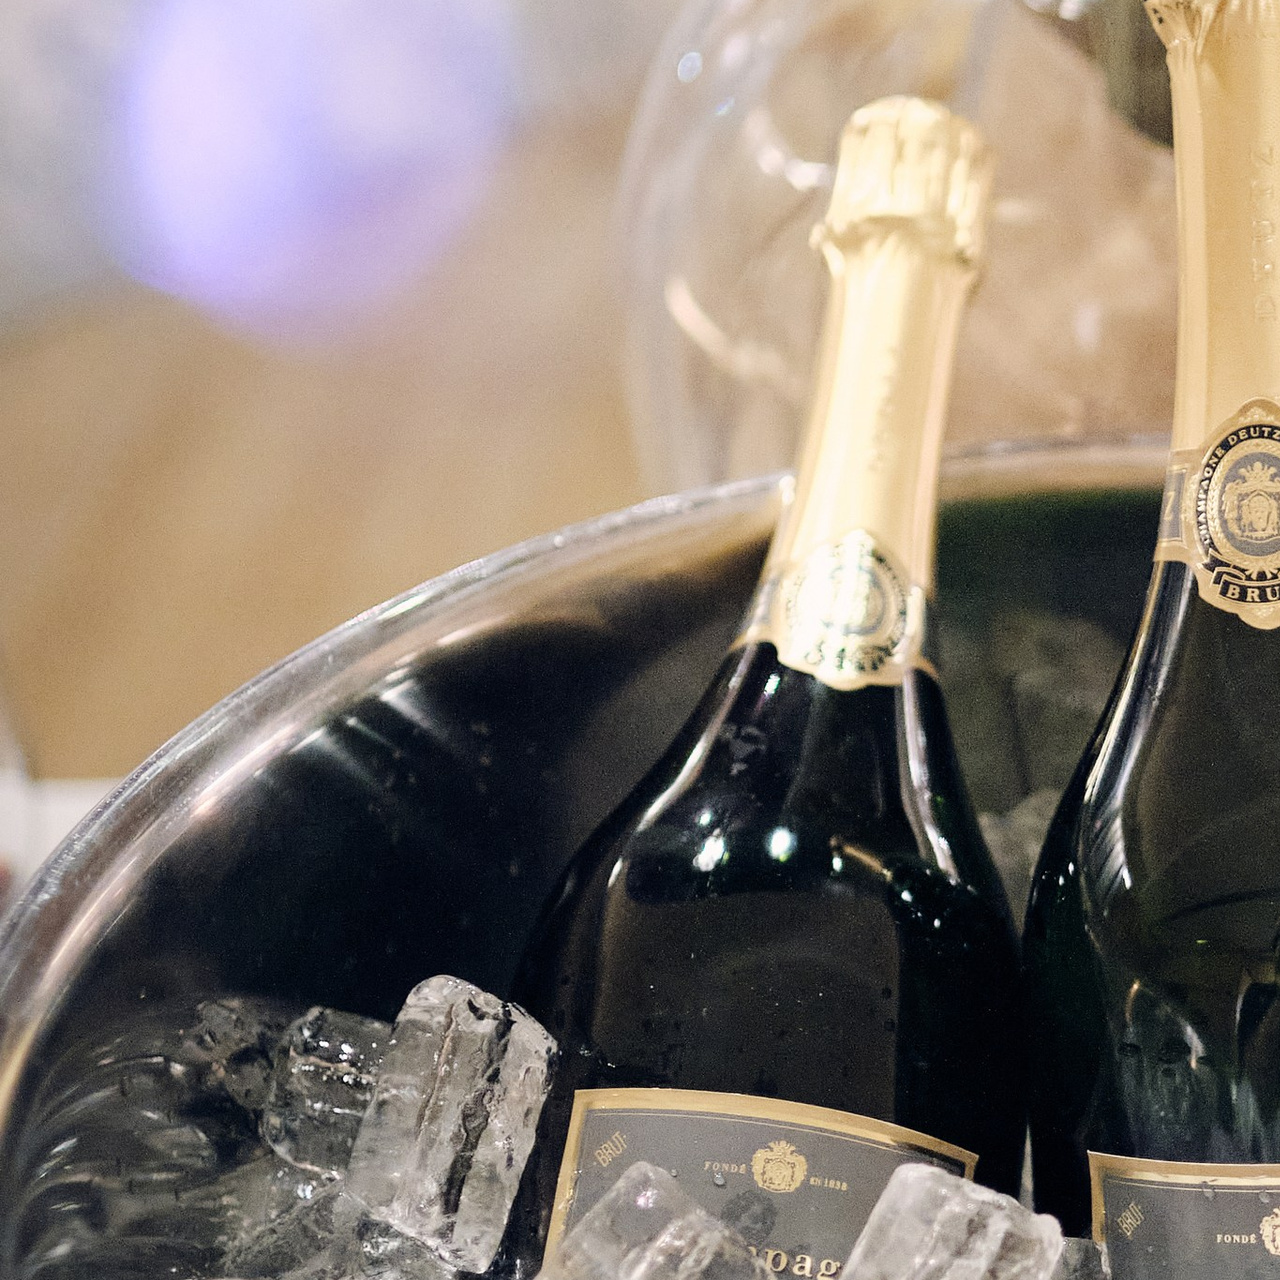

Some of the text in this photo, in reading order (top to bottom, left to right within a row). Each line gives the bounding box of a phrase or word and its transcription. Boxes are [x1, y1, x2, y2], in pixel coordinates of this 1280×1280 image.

[594, 1130, 627, 1168] BRUT
[703, 1161, 747, 1174] FONDÉ
[1117, 1202, 1144, 1237] BRUT
[1217, 1232, 1257, 1244] FONDÉ
